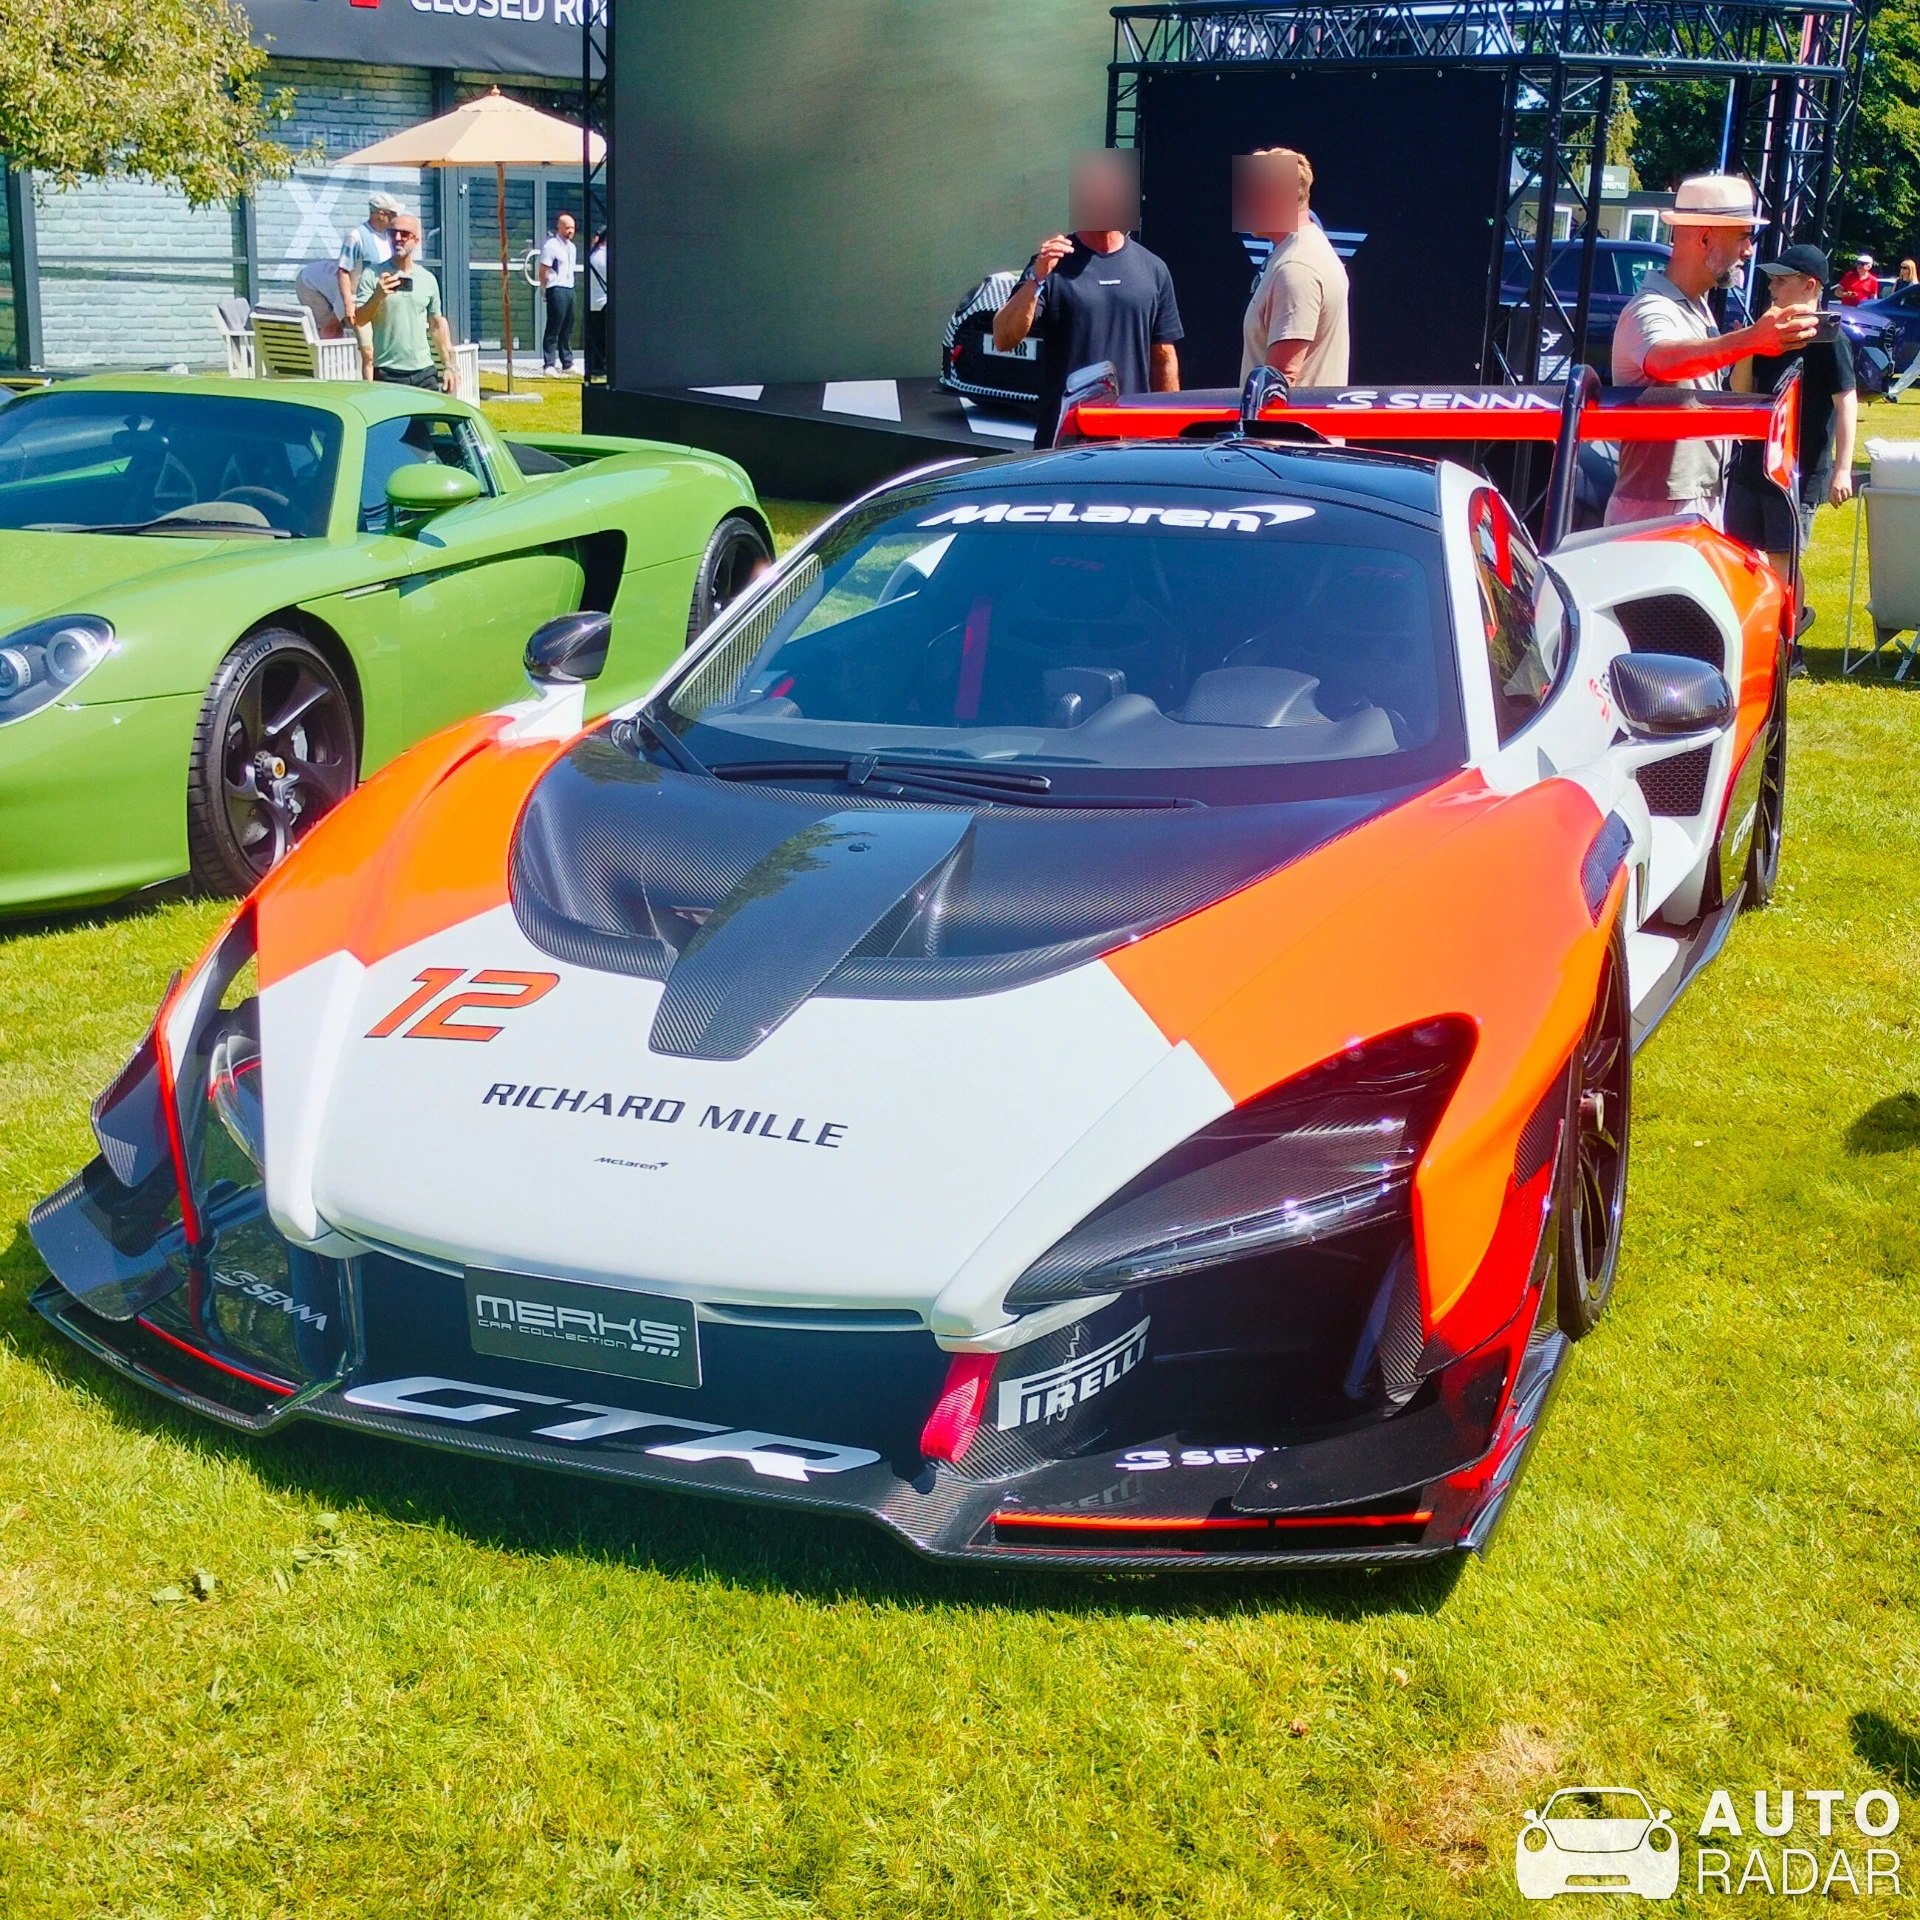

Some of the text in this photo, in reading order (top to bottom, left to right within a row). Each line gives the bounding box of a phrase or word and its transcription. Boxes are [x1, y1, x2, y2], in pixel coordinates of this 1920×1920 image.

[555, 0, 607, 27] RO
[1385, 393, 1561, 410] SENNA
[916, 503, 1272, 533] McLaren
[363, 967, 562, 1043] 12
[481, 1083, 849, 1149] RICHARD MILLE
[594, 1156, 660, 1171] McLaren
[242, 1283, 328, 1332] SENNA
[476, 1294, 681, 1348] MERKS
[478, 1319, 627, 1349] CAR COLLECTION
[997, 1315, 1152, 1432] PIRELLI
[1181, 1447, 1266, 1467] SEN
